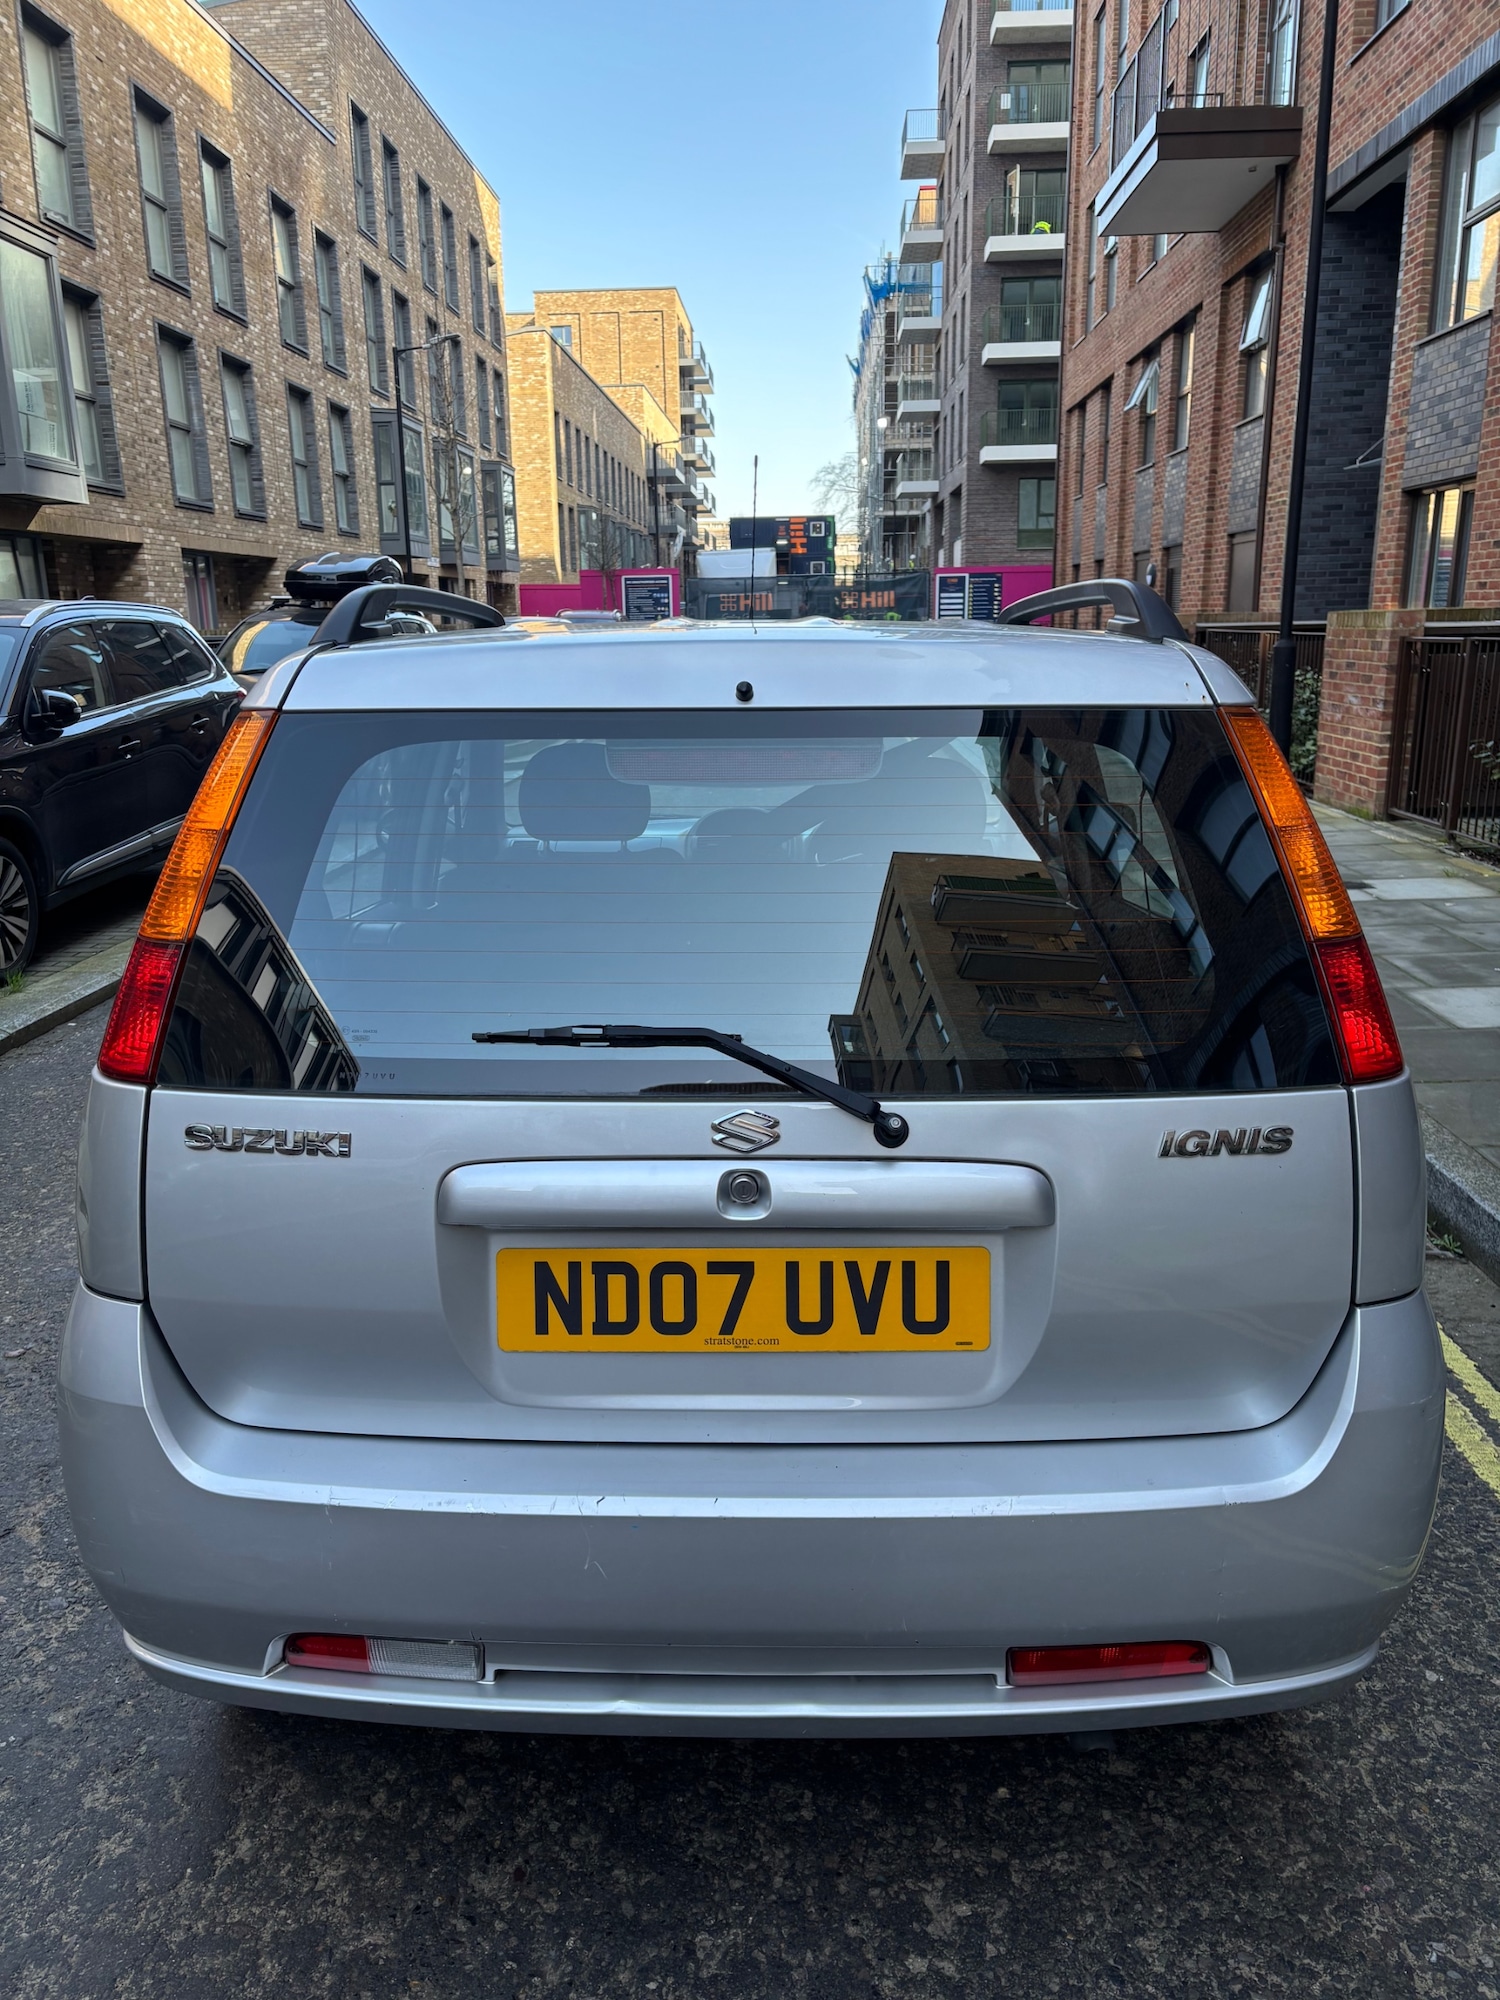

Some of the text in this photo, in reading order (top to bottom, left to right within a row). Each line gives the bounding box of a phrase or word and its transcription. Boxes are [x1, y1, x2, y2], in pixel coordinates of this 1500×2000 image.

[739, 592, 773, 611] Hill
[860, 590, 895, 609] Hill
[184, 1122, 352, 1158] SUZUKI
[1158, 1125, 1294, 1158] IGNIS
[533, 1260, 951, 1336] ND07 UVU
[703, 1336, 780, 1346] stratstone.com
